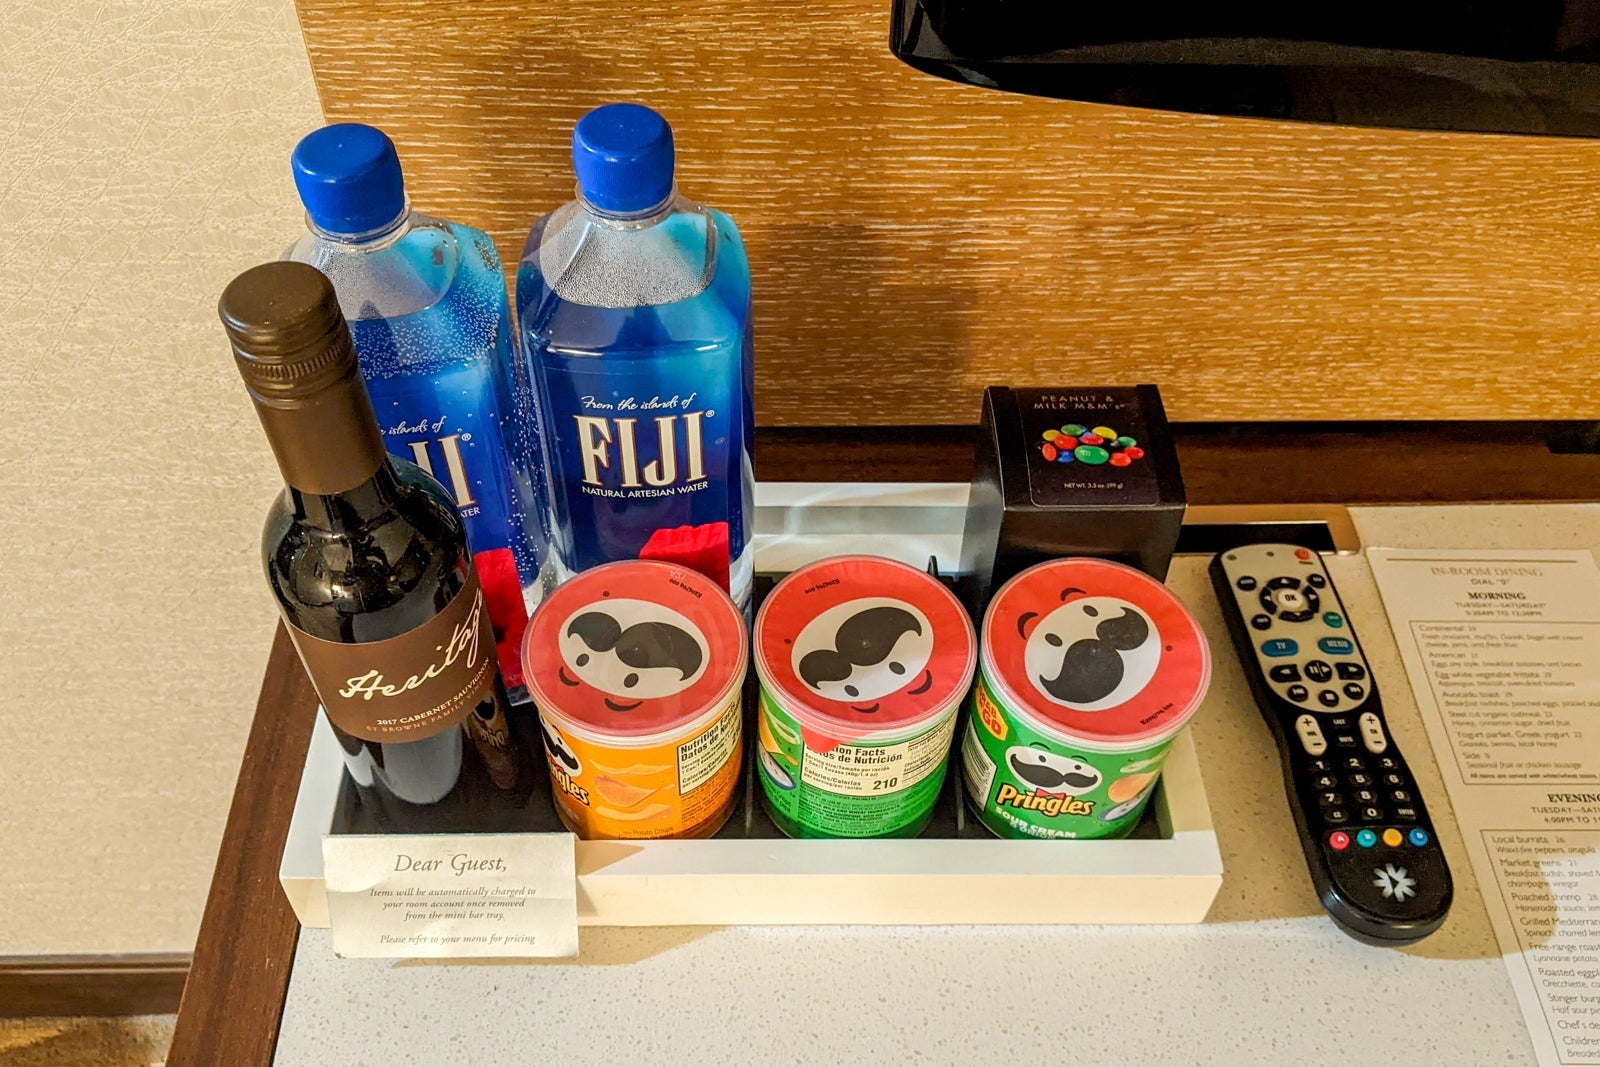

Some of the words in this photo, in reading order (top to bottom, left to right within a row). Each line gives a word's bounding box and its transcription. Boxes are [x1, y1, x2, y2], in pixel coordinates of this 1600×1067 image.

[581, 395, 613, 410] From
[617, 396, 638, 410] the
[640, 395, 679, 410] islands
[681, 392, 696, 409] of
[388, 419, 428, 435] islands
[431, 415, 447, 433] of
[572, 411, 708, 487] FIJI
[581, 486, 626, 498] NATURAL
[627, 487, 675, 498] ARTESIAN
[677, 481, 708, 494] WATER
[1430, 567, 1491, 576] IN-ROOM
[1494, 567, 1543, 577] DINING
[1470, 578, 1494, 586] DIAL
[1284, 594, 1297, 602] OK
[1467, 592, 1526, 600] MORNING
[1276, 642, 1286, 650] TV
[1326, 640, 1349, 648] MENU
[400, 700, 452, 724] CABERNET
[453, 657, 489, 702] SAUVIGNON
[381, 720, 428, 732] BROWNE
[431, 700, 464, 723] FAMILY
[680, 725, 719, 755] Nutrition
[681, 743, 708, 762] Datos
[709, 734, 719, 746] de
[855, 748, 886, 756] Facts
[838, 755, 851, 763] de
[854, 754, 902, 765] Nutrición
[1462, 751, 1481, 759] Side
[1316, 761, 1324, 769] 1
[1349, 758, 1360, 767] 2
[1383, 758, 1393, 767] 3
[872, 777, 898, 790] 210
[1320, 777, 1331, 786] 4
[1355, 775, 1365, 783] 5
[1389, 775, 1399, 783] 6
[995, 782, 1097, 818] Pringles
[1325, 793, 1335, 802] 7
[1360, 791, 1371, 800] 8
[1395, 791, 1405, 800] 9
[1367, 808, 1377, 817] 0
[995, 806, 1028, 828] SOUR
[1029, 825, 1077, 839] CREAM
[653, 826, 674, 834] Crisps
[1491, 835, 1515, 844] Local
[394, 854, 443, 872] Dear
[451, 853, 507, 877] Guest,
[1500, 859, 1530, 867] Market
[1504, 869, 1539, 878] Breakfast
[1507, 880, 1550, 889] champagne
[369, 888, 394, 897] Items
[396, 887, 414, 897] will
[416, 887, 426, 897] be
[428, 886, 489, 898] automatically
[490, 885, 526, 898] charged
[527, 887, 536, 896] to
[1511, 892, 1550, 901] Poached
[382, 901, 403, 911] your
[466, 900, 487, 908] once
[488, 899, 526, 908] removed
[403, 911, 426, 922] from
[428, 911, 443, 919] the
[445, 911, 467, 919] mini
[468, 910, 484, 919] bar
[486, 911, 505, 921] tray.
[1520, 917, 1550, 926] Grilled
[380, 935, 407, 944] Please
[408, 934, 429, 946] refer
[430, 935, 439, 943] to
[440, 936, 462, 946] your
[463, 935, 487, 943] menu
[488, 933, 503, 945] for
[503, 934, 536, 945] pricing
[1529, 942, 1577, 954] Free-range
[1538, 967, 1575, 977] Roasted
[1547, 993, 1579, 1005] Stinger
